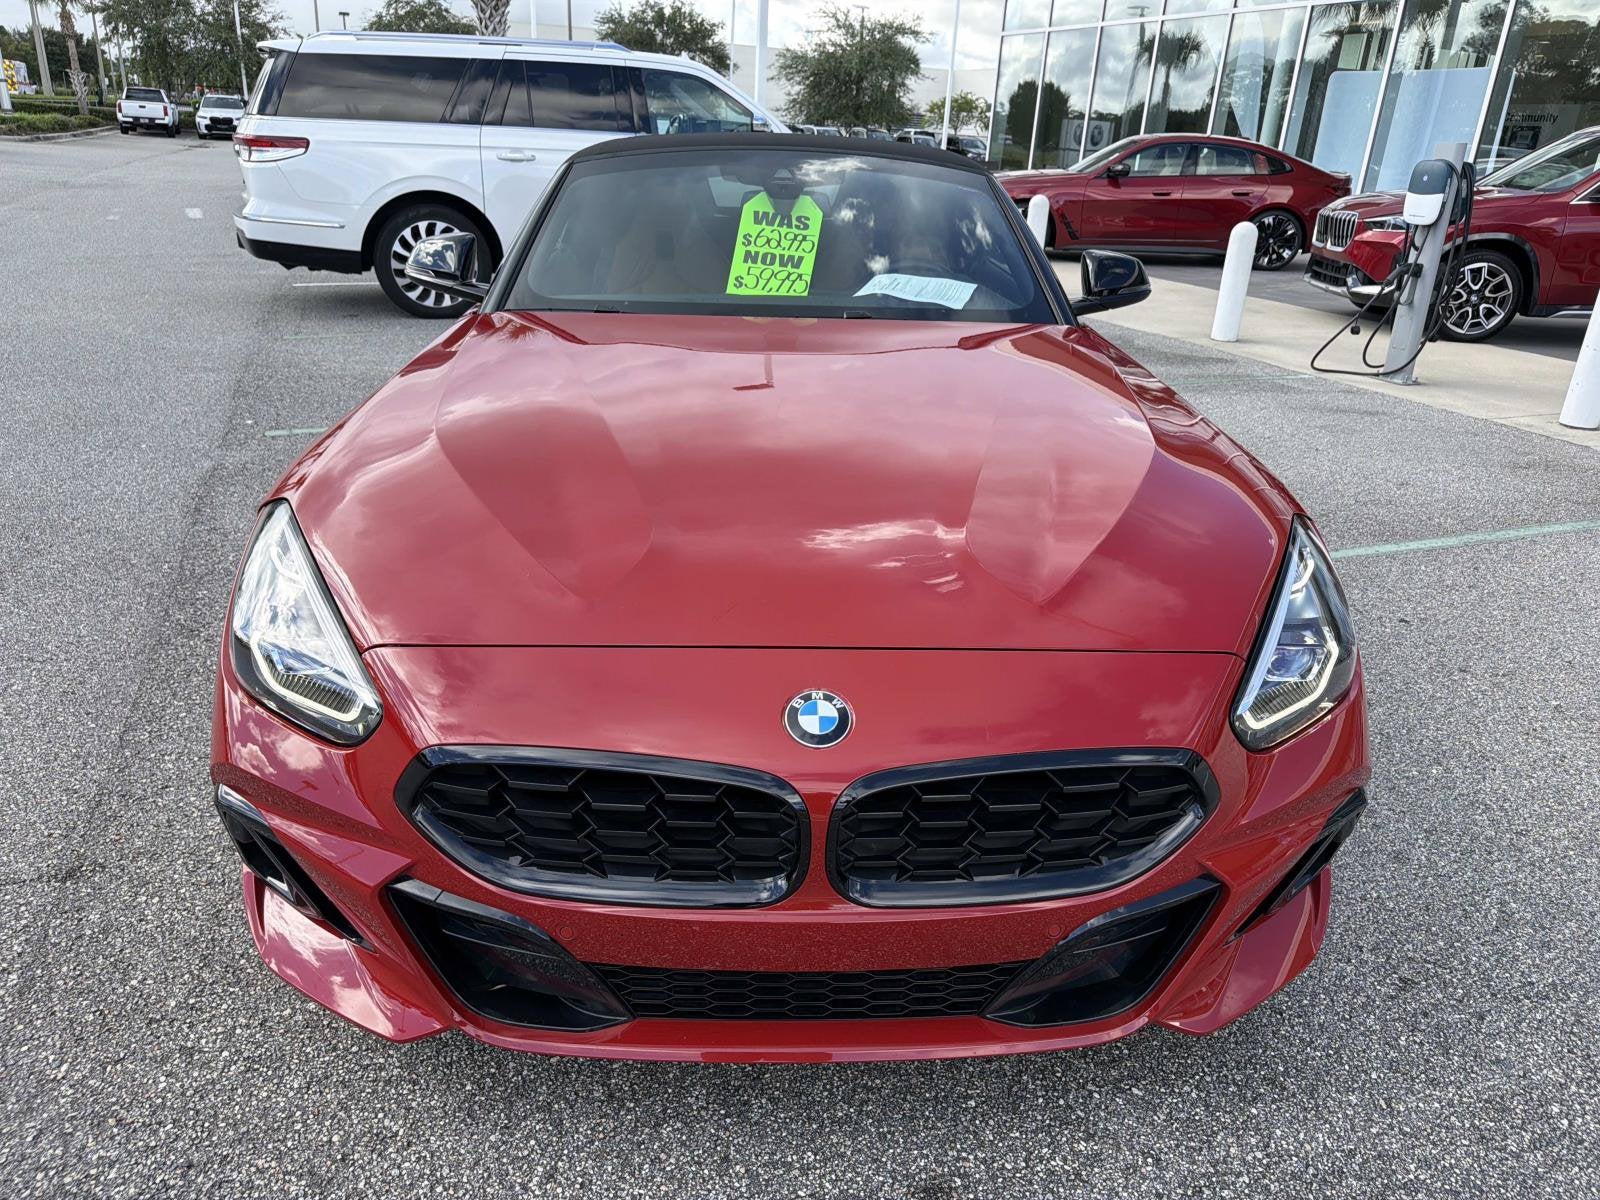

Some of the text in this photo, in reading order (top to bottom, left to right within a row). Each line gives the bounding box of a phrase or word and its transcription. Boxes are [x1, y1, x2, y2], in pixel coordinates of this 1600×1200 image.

[753, 210, 811, 231] WAS
[743, 249, 806, 270] NOW
[733, 266, 811, 295] $59,995
[792, 692, 844, 709] BMW
